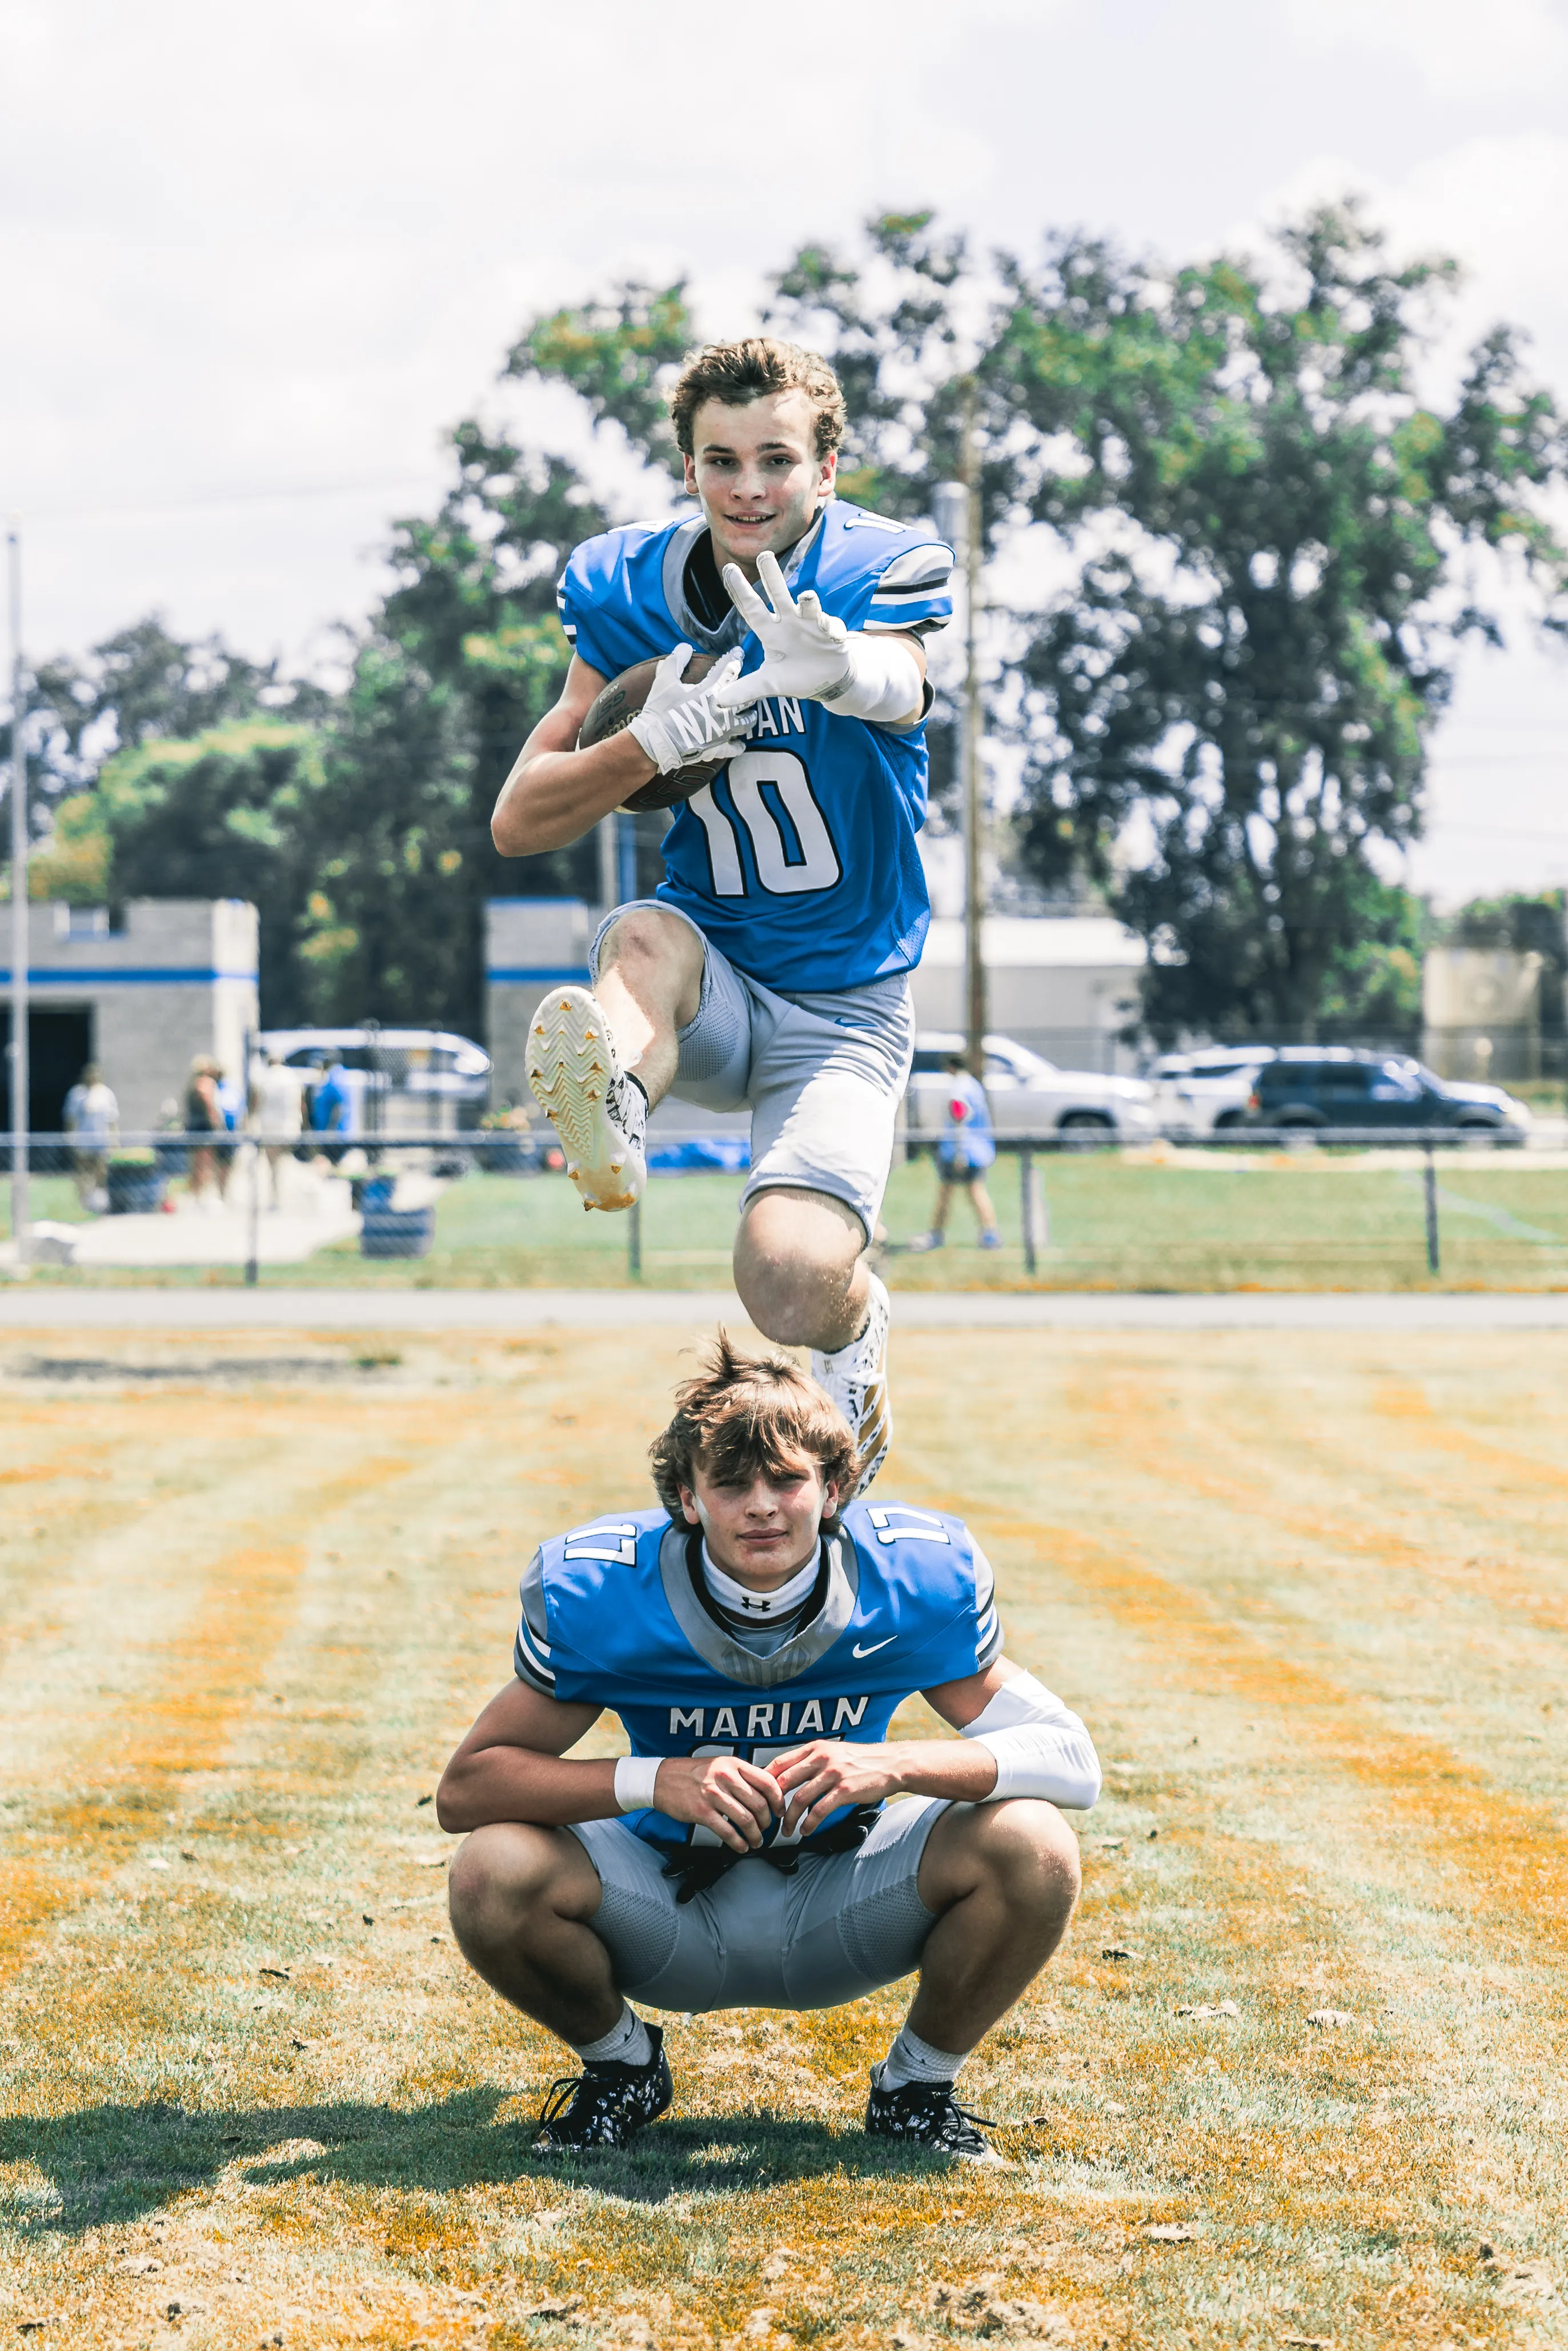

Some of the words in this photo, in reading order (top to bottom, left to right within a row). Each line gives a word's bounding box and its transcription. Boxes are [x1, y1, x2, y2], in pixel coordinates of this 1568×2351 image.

[686, 748, 843, 899] 10
[563, 1524, 637, 1568] 17
[866, 1507, 951, 1546] 17
[669, 1696, 870, 1738] MARIAN
